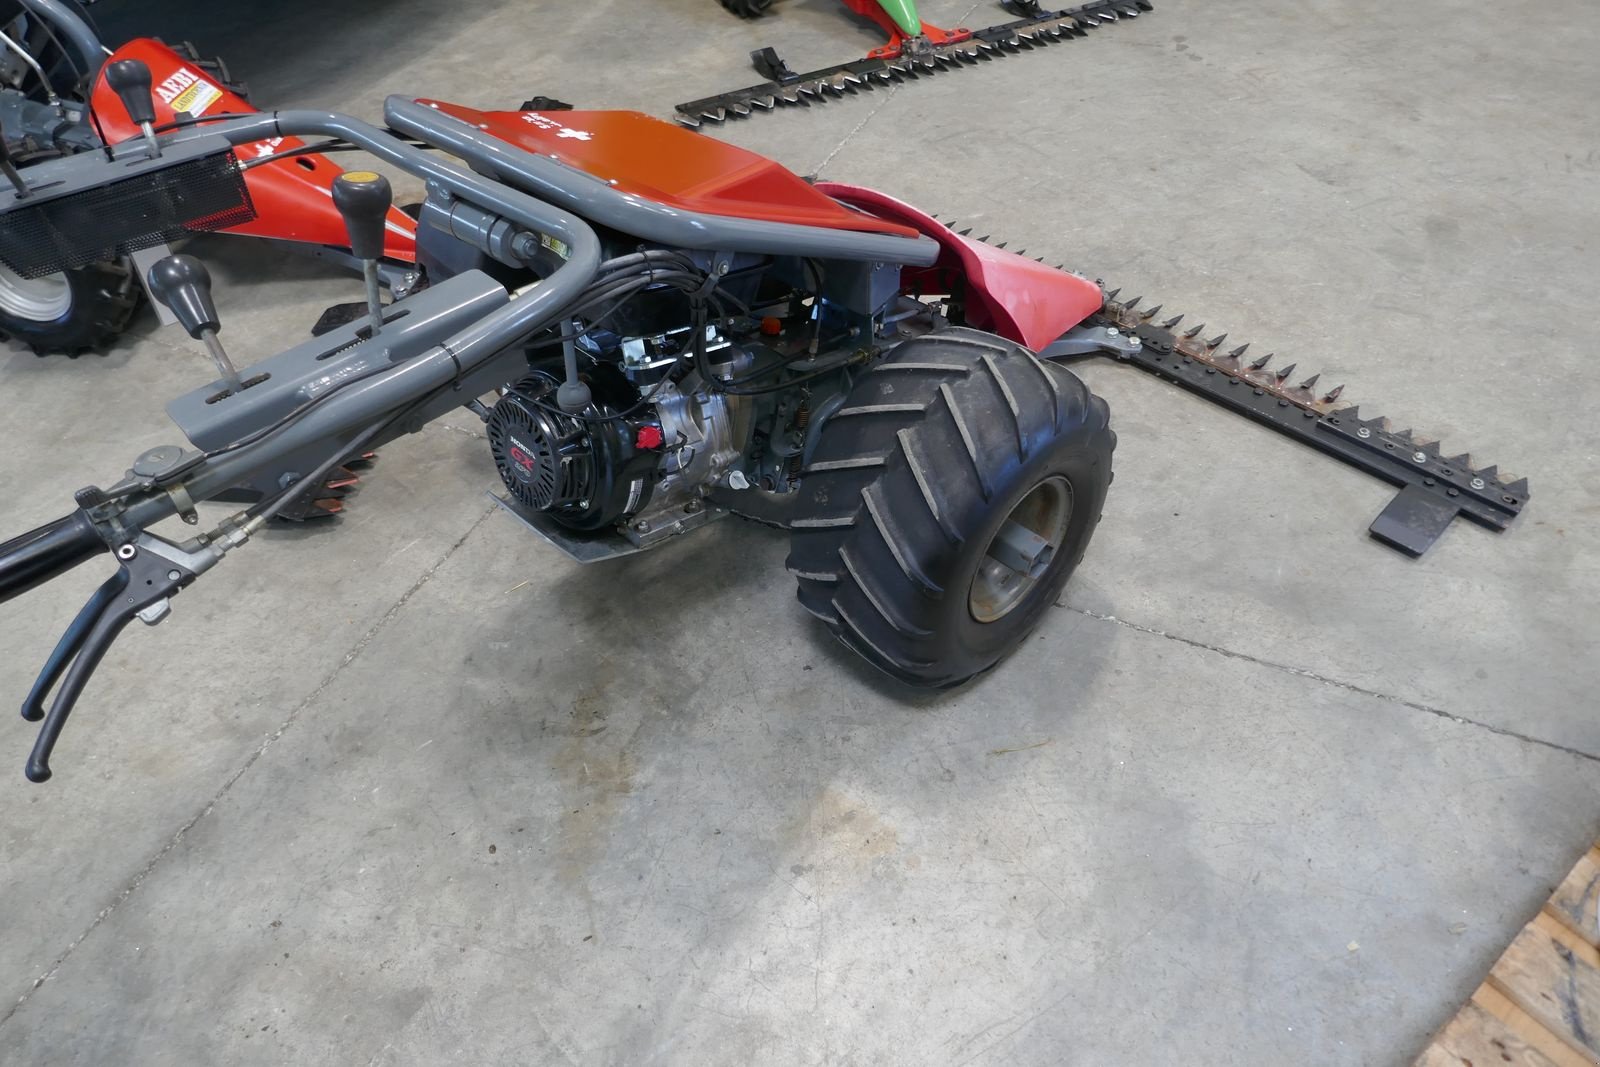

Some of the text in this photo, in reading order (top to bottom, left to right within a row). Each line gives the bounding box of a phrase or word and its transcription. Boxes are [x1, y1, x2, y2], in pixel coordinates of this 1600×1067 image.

[155, 67, 199, 104] AEBI
[510, 435, 536, 460] HONDA
[511, 447, 535, 471] GX
